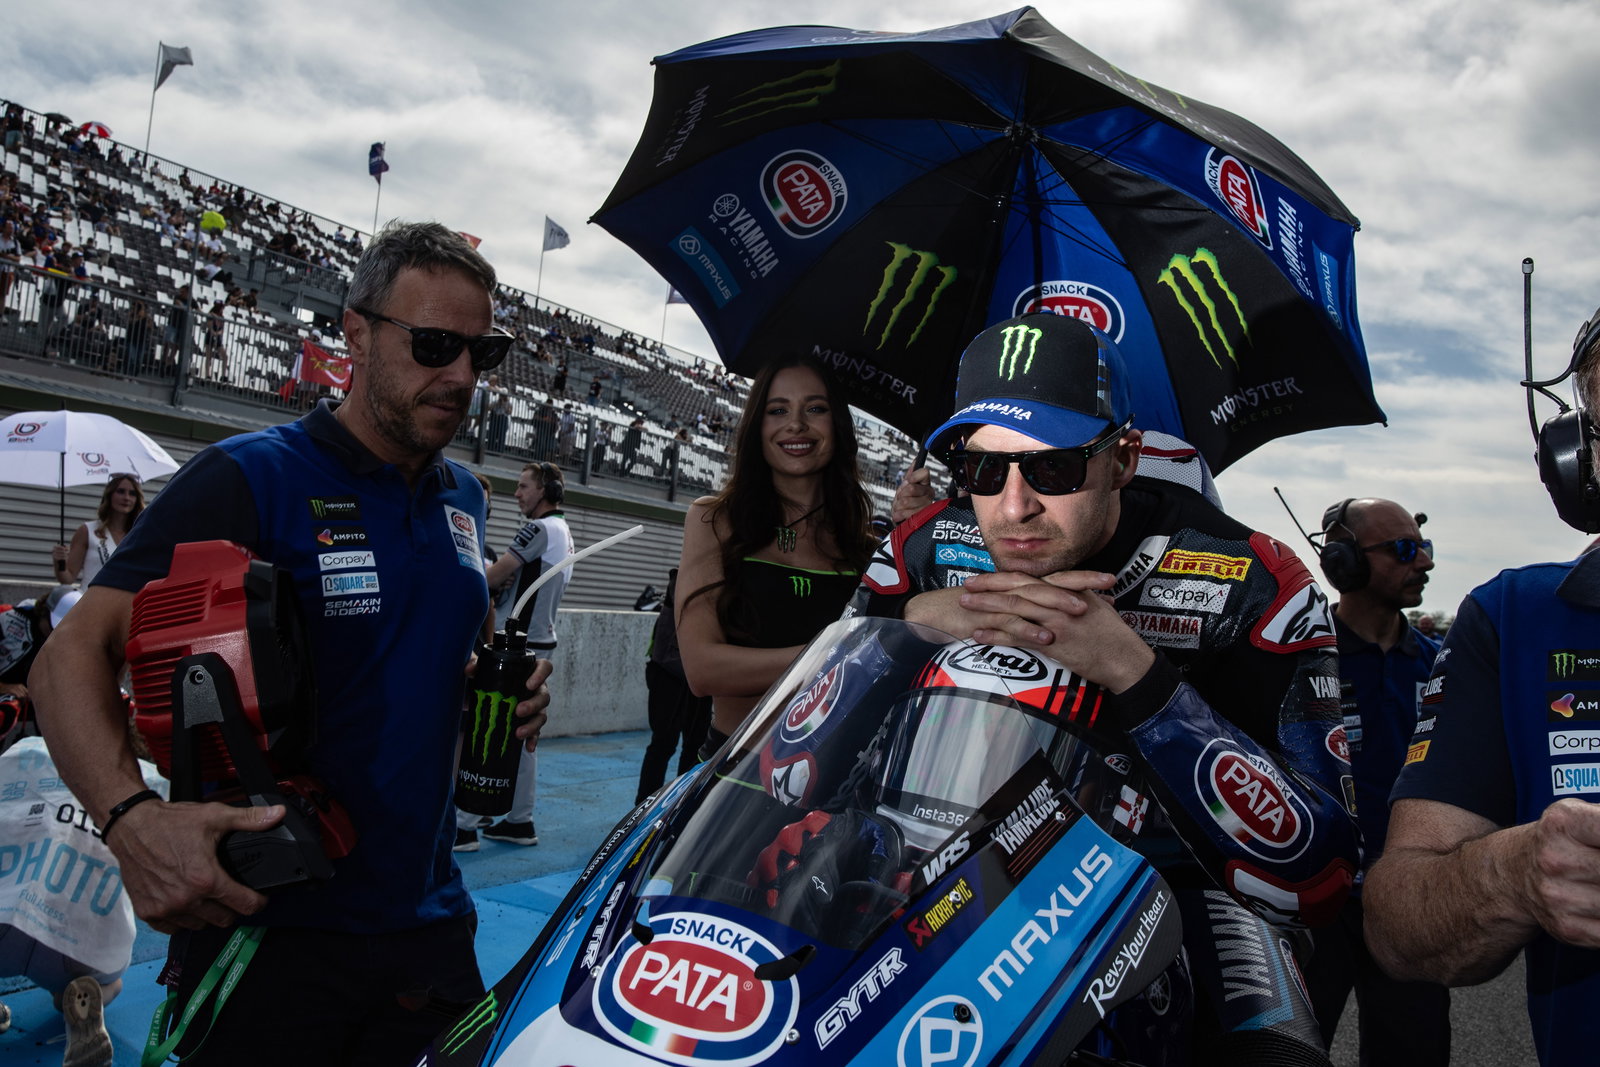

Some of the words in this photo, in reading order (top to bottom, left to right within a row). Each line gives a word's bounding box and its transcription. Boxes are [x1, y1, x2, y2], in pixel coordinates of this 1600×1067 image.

[783, 168, 826, 220] PATA
[820, 164, 845, 199] SNACK
[1227, 171, 1256, 229] PATA
[728, 207, 779, 279] YAMAHA
[698, 253, 733, 300] MAXUS
[1041, 284, 1086, 296] SNACK
[810, 344, 919, 406] MONSTER
[950, 402, 1032, 421] YAMAHA
[1209, 376, 1304, 425] MONSTER
[333, 533, 366, 541] AMPITO
[322, 555, 367, 567] Corpay
[1161, 553, 1247, 577] PIRELLI
[333, 576, 365, 592] SQUARE
[1147, 584, 1217, 607] Corpay
[325, 598, 382, 609] SEMAKIN
[338, 606, 380, 616] DEPAN
[1139, 615, 1200, 636] YAMAHA
[458, 769, 511, 789] MONSTER
[1248, 757, 1293, 798] SNACK
[1221, 760, 1286, 837] PATA
[671, 917, 751, 956] SNACK
[976, 843, 1113, 1002] MAXUS
[1083, 955, 1125, 1020] Revs
[1119, 926, 1147, 969] Your
[1139, 890, 1167, 933] Heart
[628, 949, 740, 1023] PATA
[814, 946, 908, 1051] GYTR
[149, 1031, 159, 1047] PIT
